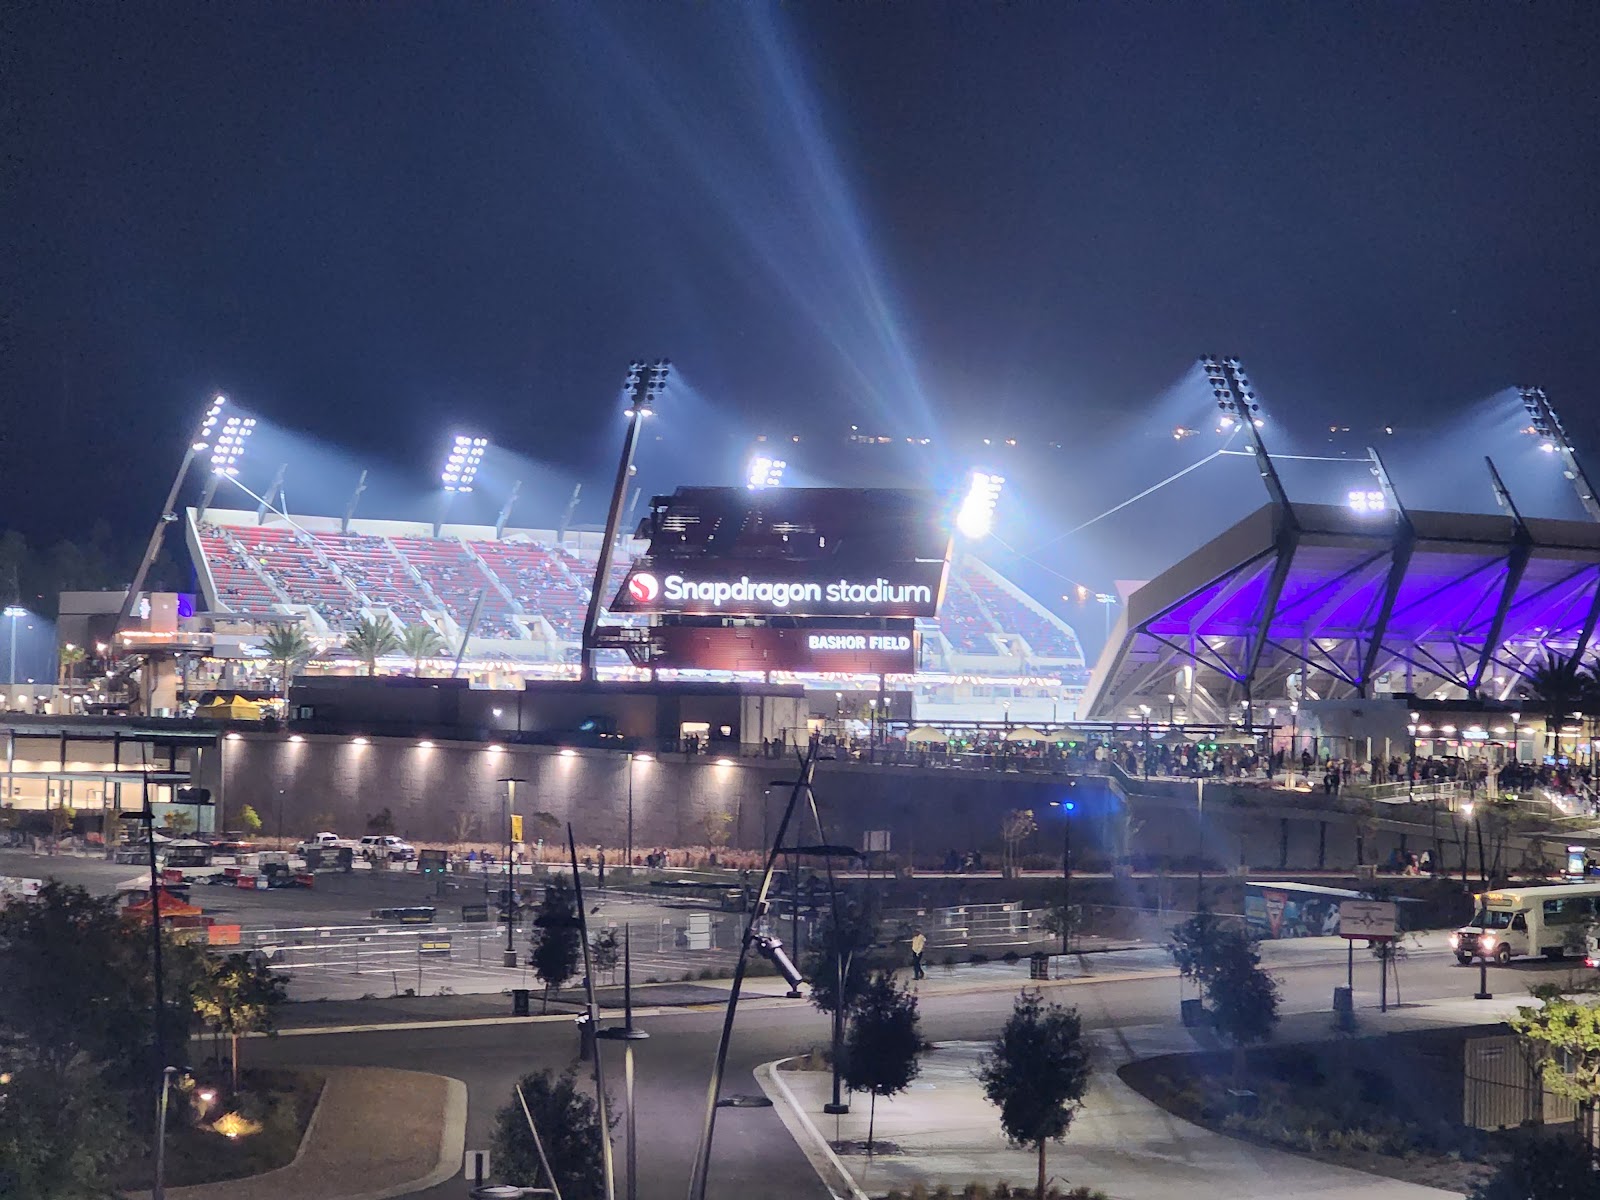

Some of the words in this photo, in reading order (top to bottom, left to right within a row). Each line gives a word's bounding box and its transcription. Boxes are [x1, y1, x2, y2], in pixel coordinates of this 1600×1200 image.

[663, 575, 821, 607] Snapdragon
[826, 577, 931, 603] stadium
[808, 635, 866, 650] BASHOR
[869, 635, 911, 651] FIELD
